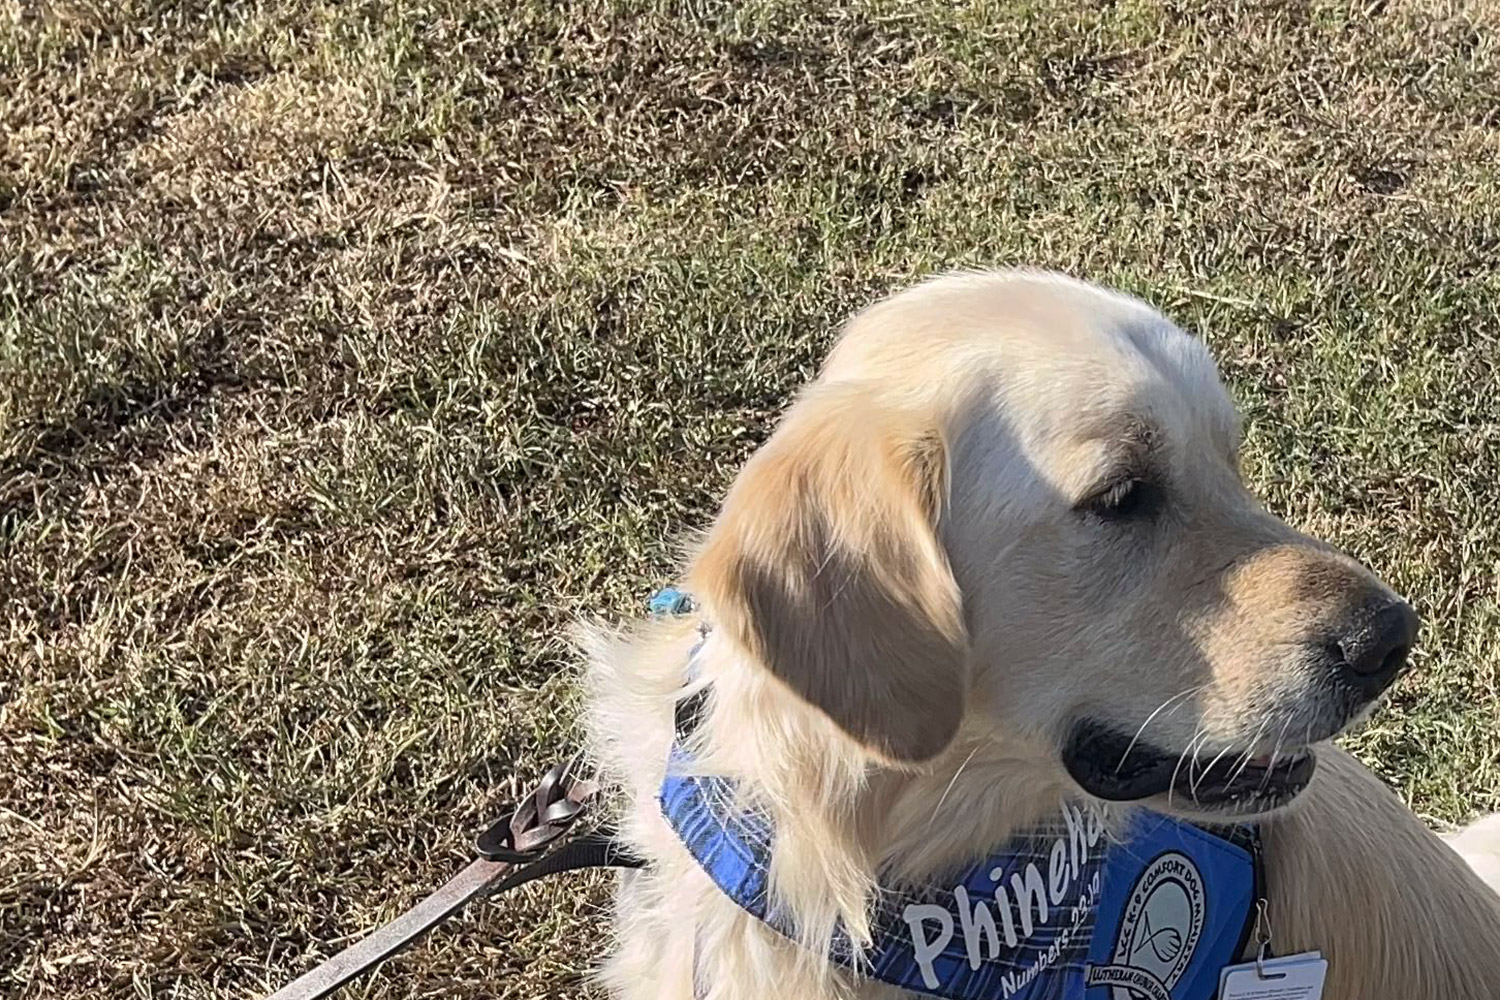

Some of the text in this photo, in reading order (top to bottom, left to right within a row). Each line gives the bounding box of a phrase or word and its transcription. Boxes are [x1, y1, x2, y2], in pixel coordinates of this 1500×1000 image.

[903, 795, 1105, 990] Phineha
[1142, 860, 1186, 894] COMFORT
[1184, 868, 1201, 899] DOG
[1001, 928, 1070, 1000] Numbers
[1092, 968, 1134, 983] LUTHERAN
